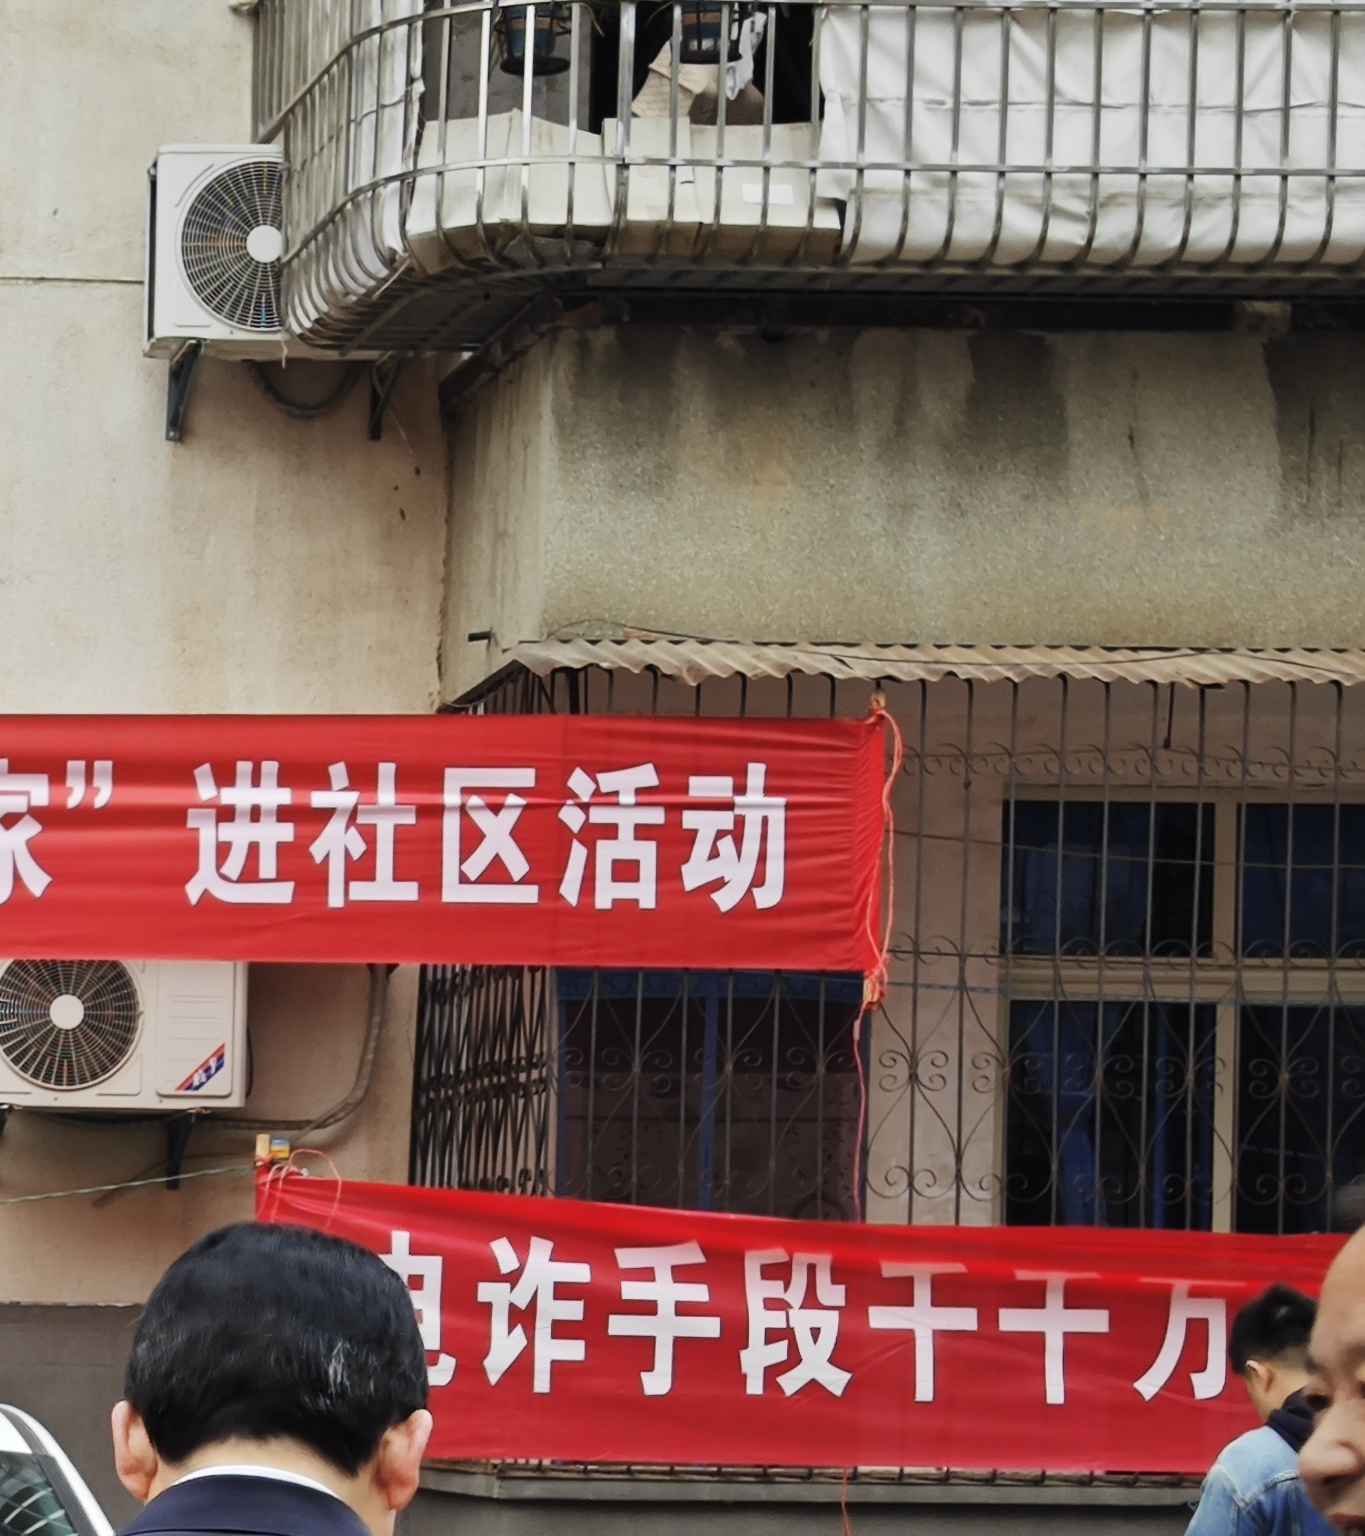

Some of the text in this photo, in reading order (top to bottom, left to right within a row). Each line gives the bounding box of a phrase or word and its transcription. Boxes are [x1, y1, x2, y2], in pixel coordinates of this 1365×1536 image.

[184, 760, 789, 913] 进社区活动
